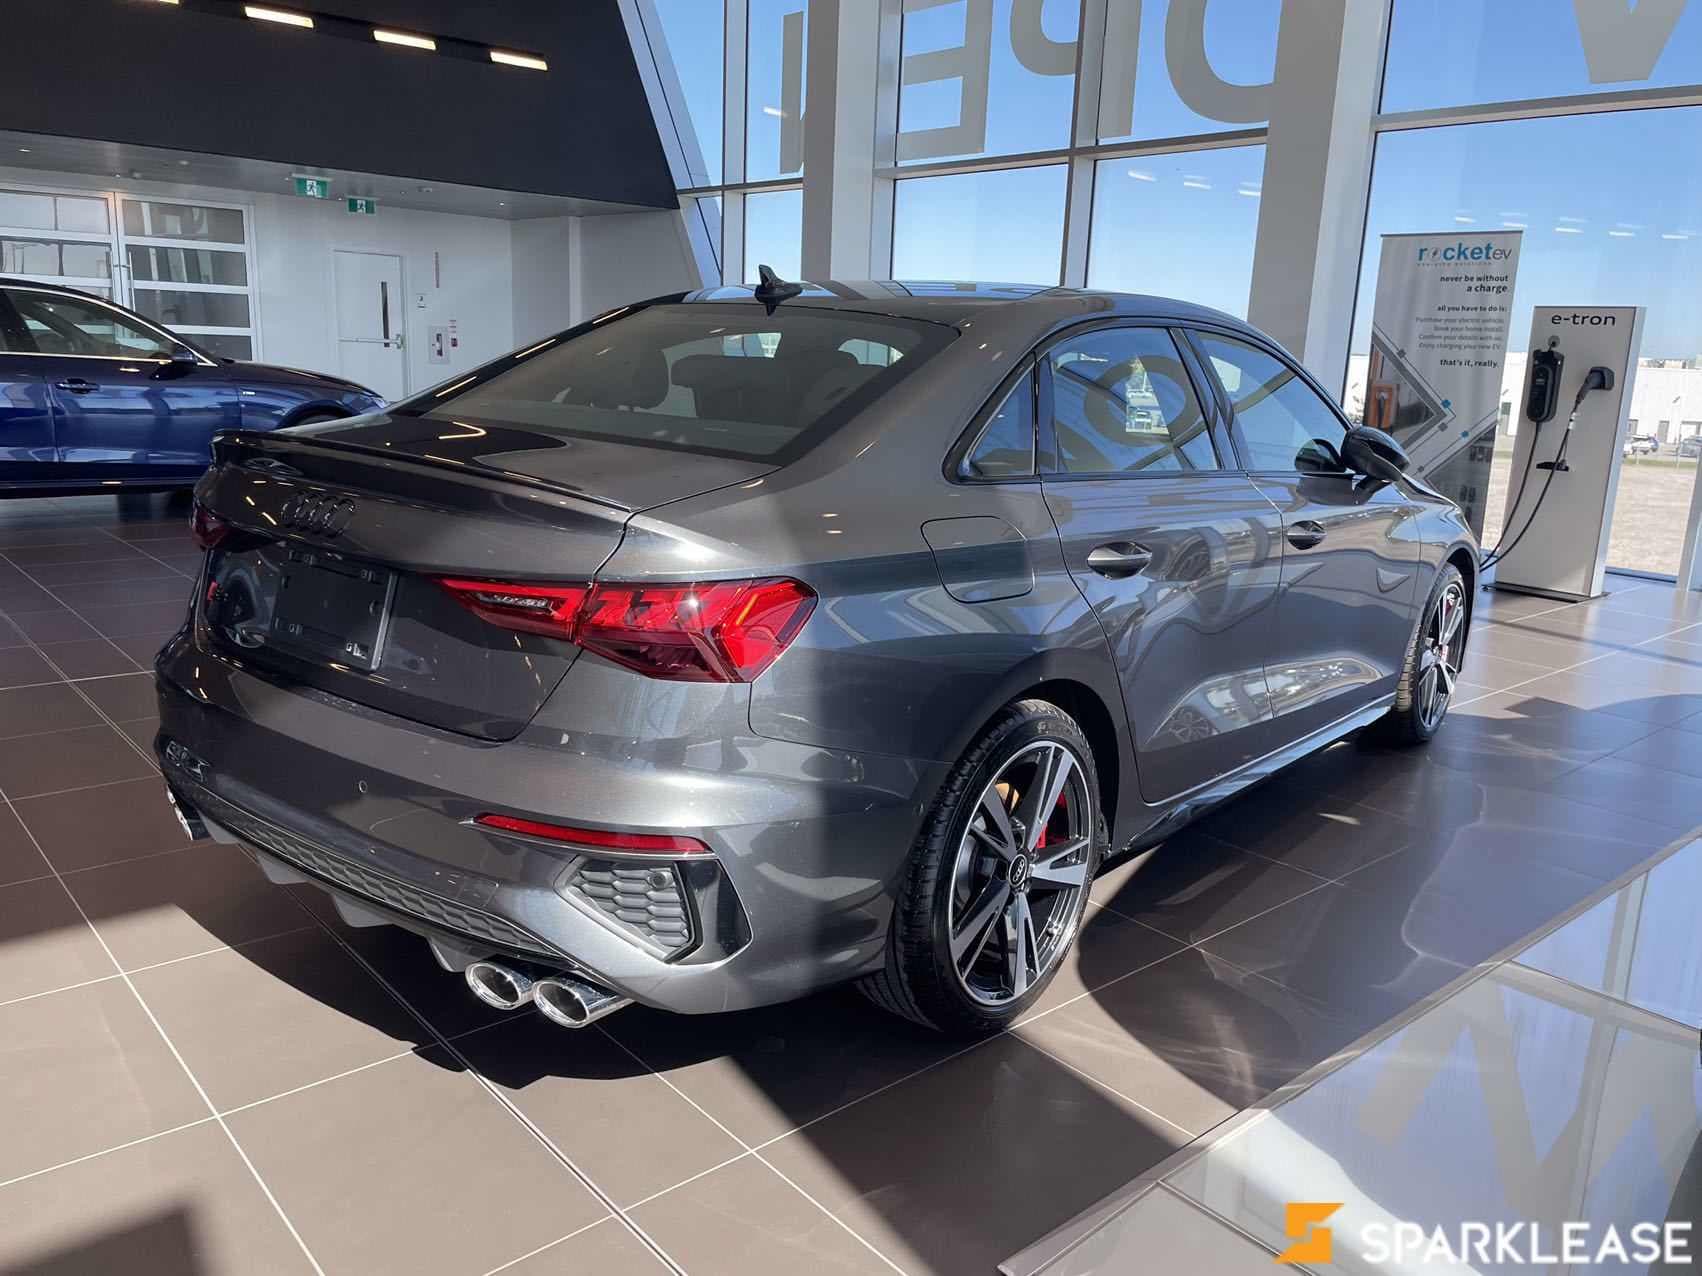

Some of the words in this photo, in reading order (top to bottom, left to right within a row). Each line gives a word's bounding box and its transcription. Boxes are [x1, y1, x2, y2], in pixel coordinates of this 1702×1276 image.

[1439, 275, 1463, 283] never
[1464, 274, 1475, 283] be
[1476, 274, 1509, 282] without
[1466, 284, 1473, 293] a
[1437, 304, 1446, 312] all
[1447, 305, 1460, 313] you
[1461, 304, 1478, 312] have
[1479, 304, 1487, 312] to
[1488, 303, 1498, 312] do
[1551, 313, 1617, 327] e-tron
[1440, 359, 1463, 367] that's
